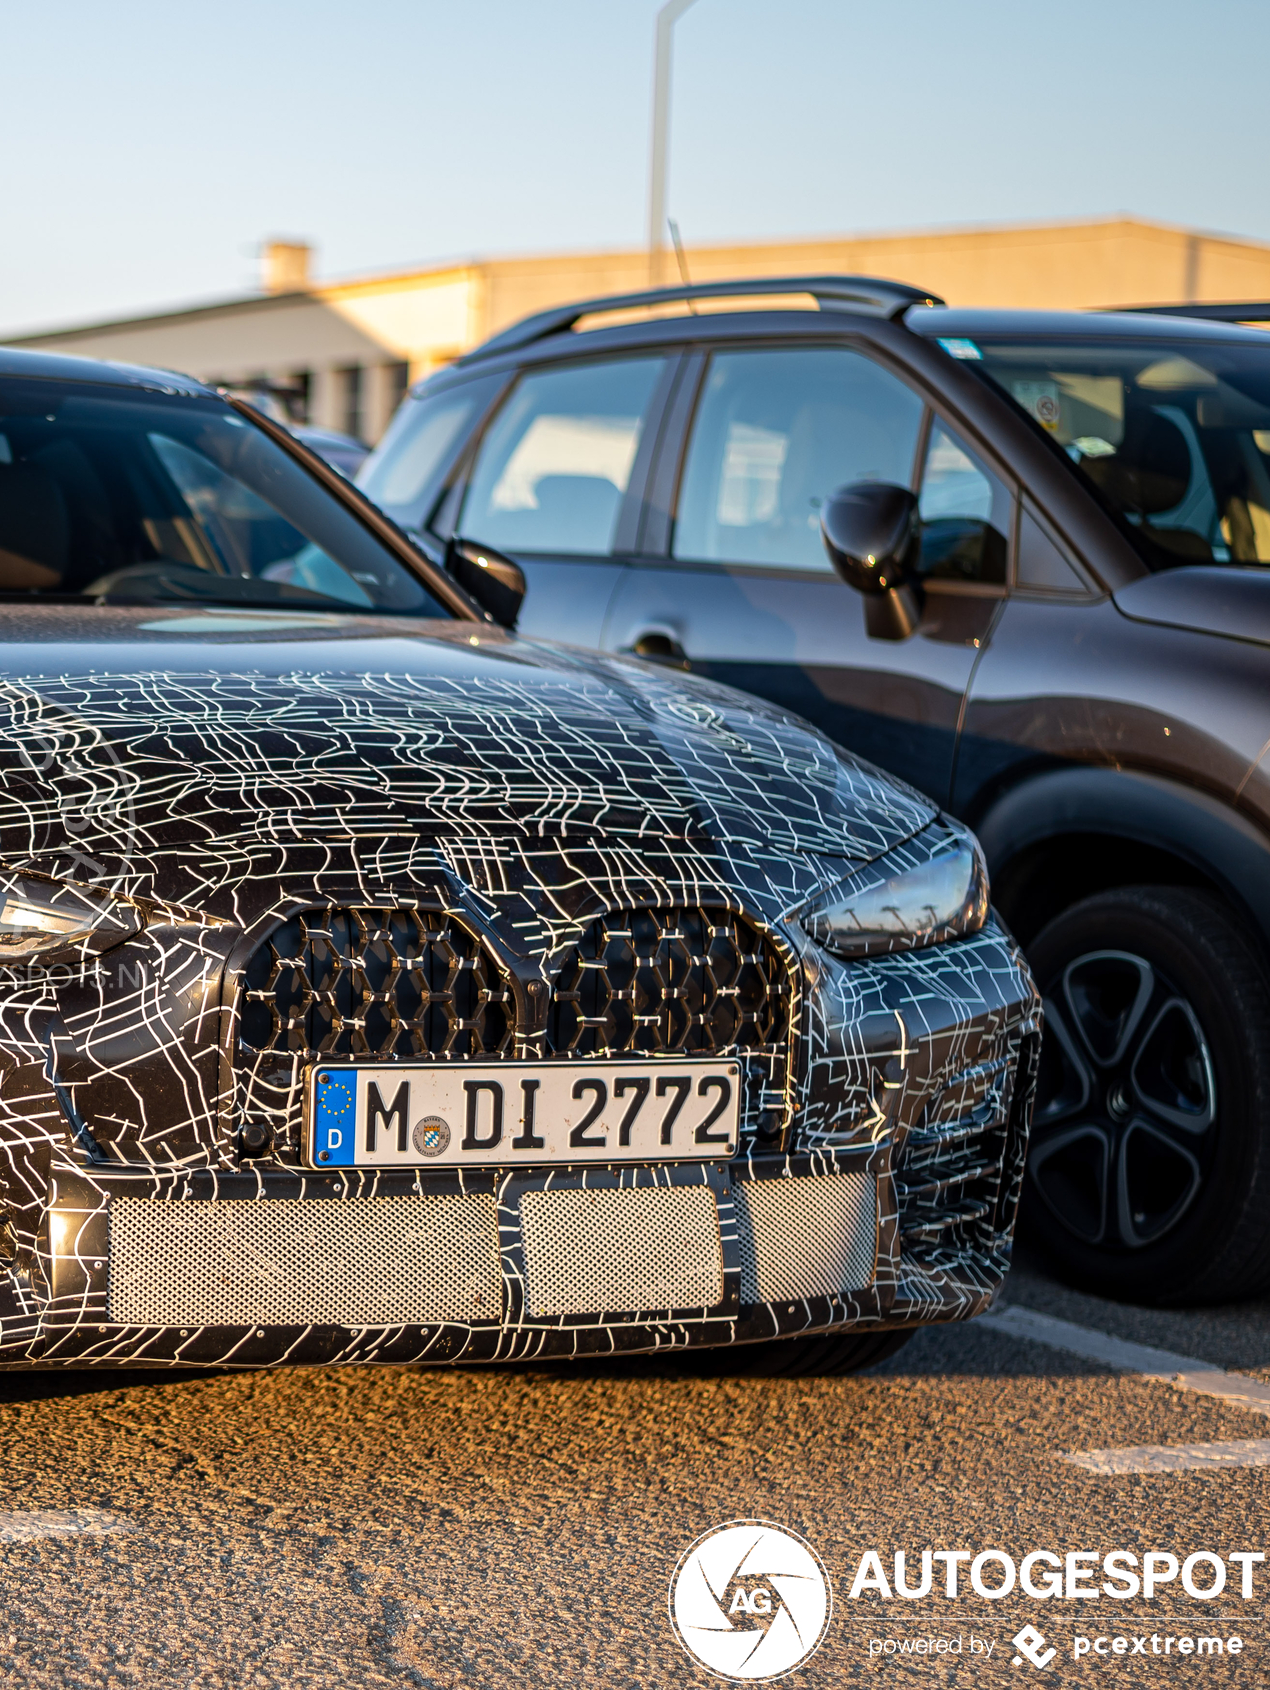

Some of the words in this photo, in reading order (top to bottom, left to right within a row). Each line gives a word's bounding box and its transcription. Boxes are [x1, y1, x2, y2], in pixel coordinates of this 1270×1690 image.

[365, 1080, 410, 1152] M
[461, 1079, 545, 1150] DI
[570, 1075, 731, 1148] 2772
[328, 1129, 343, 1149] D
